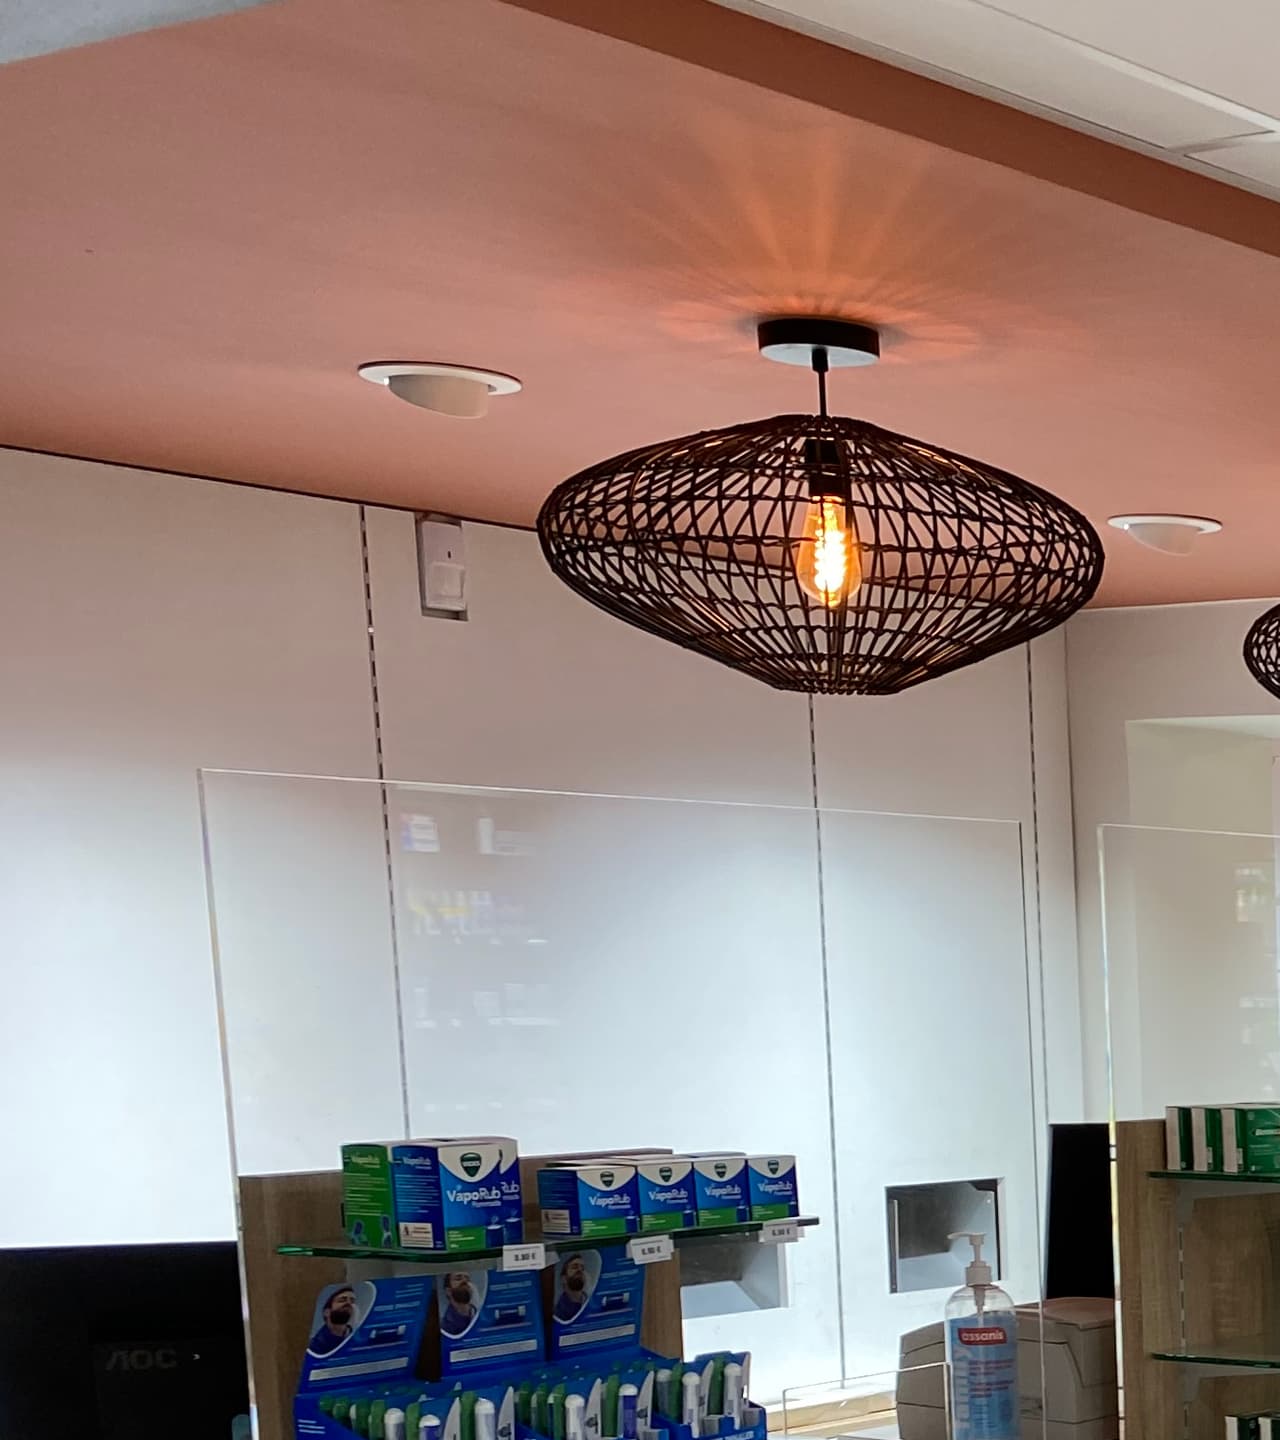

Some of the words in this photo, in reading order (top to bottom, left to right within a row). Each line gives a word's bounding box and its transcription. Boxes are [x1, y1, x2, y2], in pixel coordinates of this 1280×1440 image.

[446, 1185, 501, 1205] VapoRub
[588, 1192, 631, 1207] VapoRub
[648, 1187, 688, 1201] VapoRub
[961, 1330, 1004, 1342] assanis
